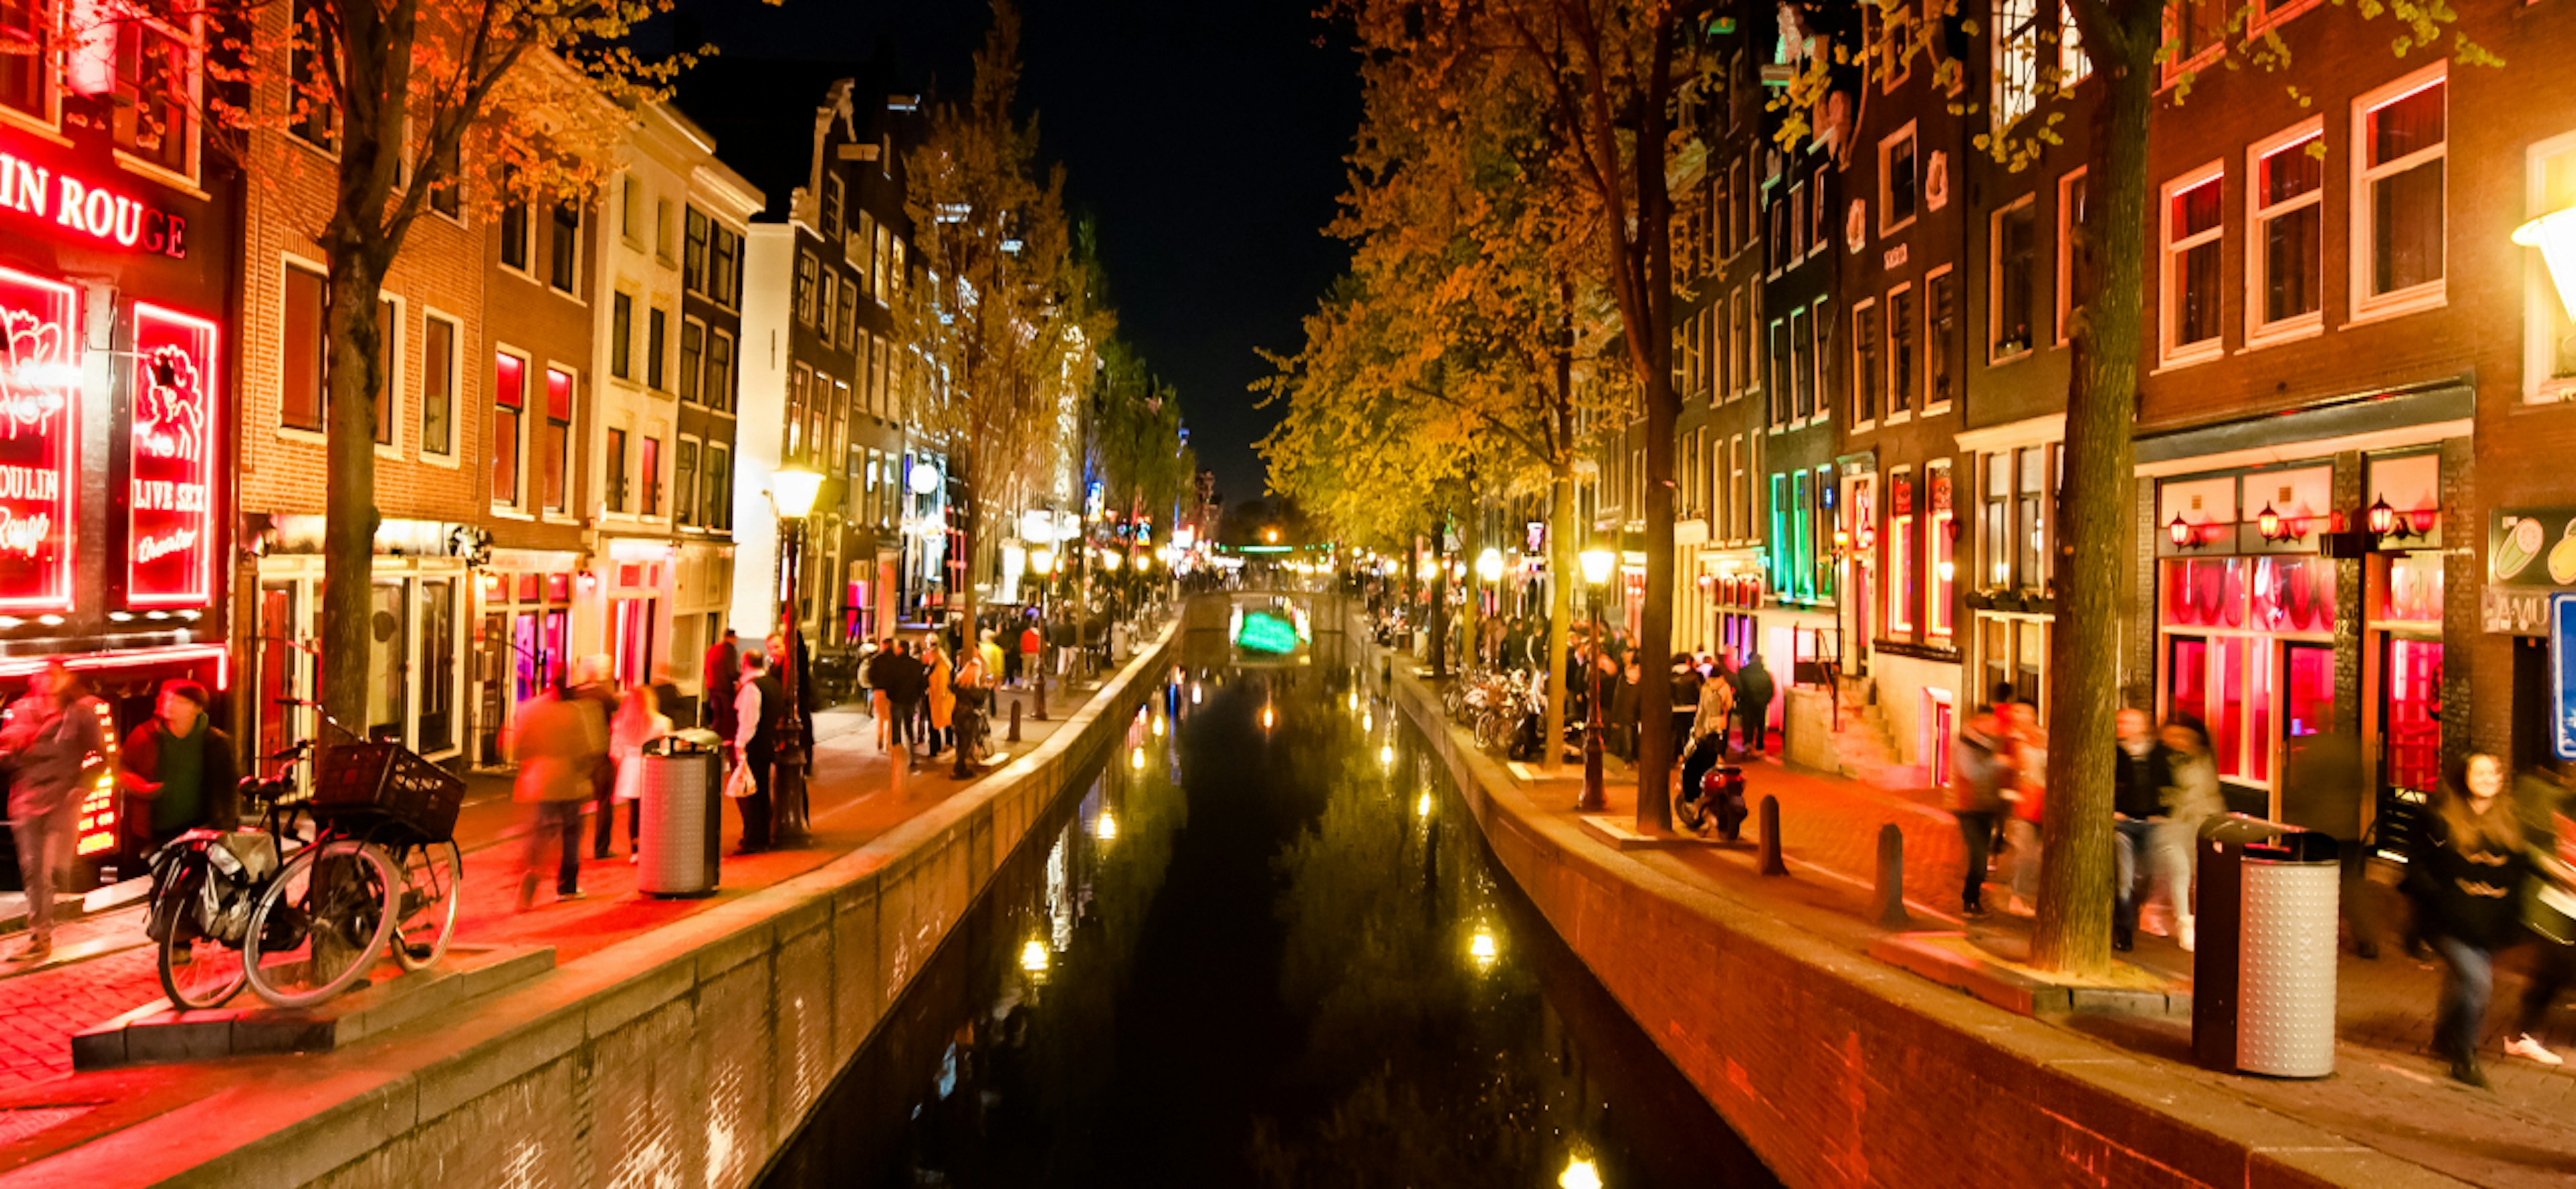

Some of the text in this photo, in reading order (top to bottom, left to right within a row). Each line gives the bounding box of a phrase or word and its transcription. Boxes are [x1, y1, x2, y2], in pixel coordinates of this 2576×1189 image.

[57, 175, 186, 259] ROUGE
[134, 478, 205, 512] LIVE SEX
